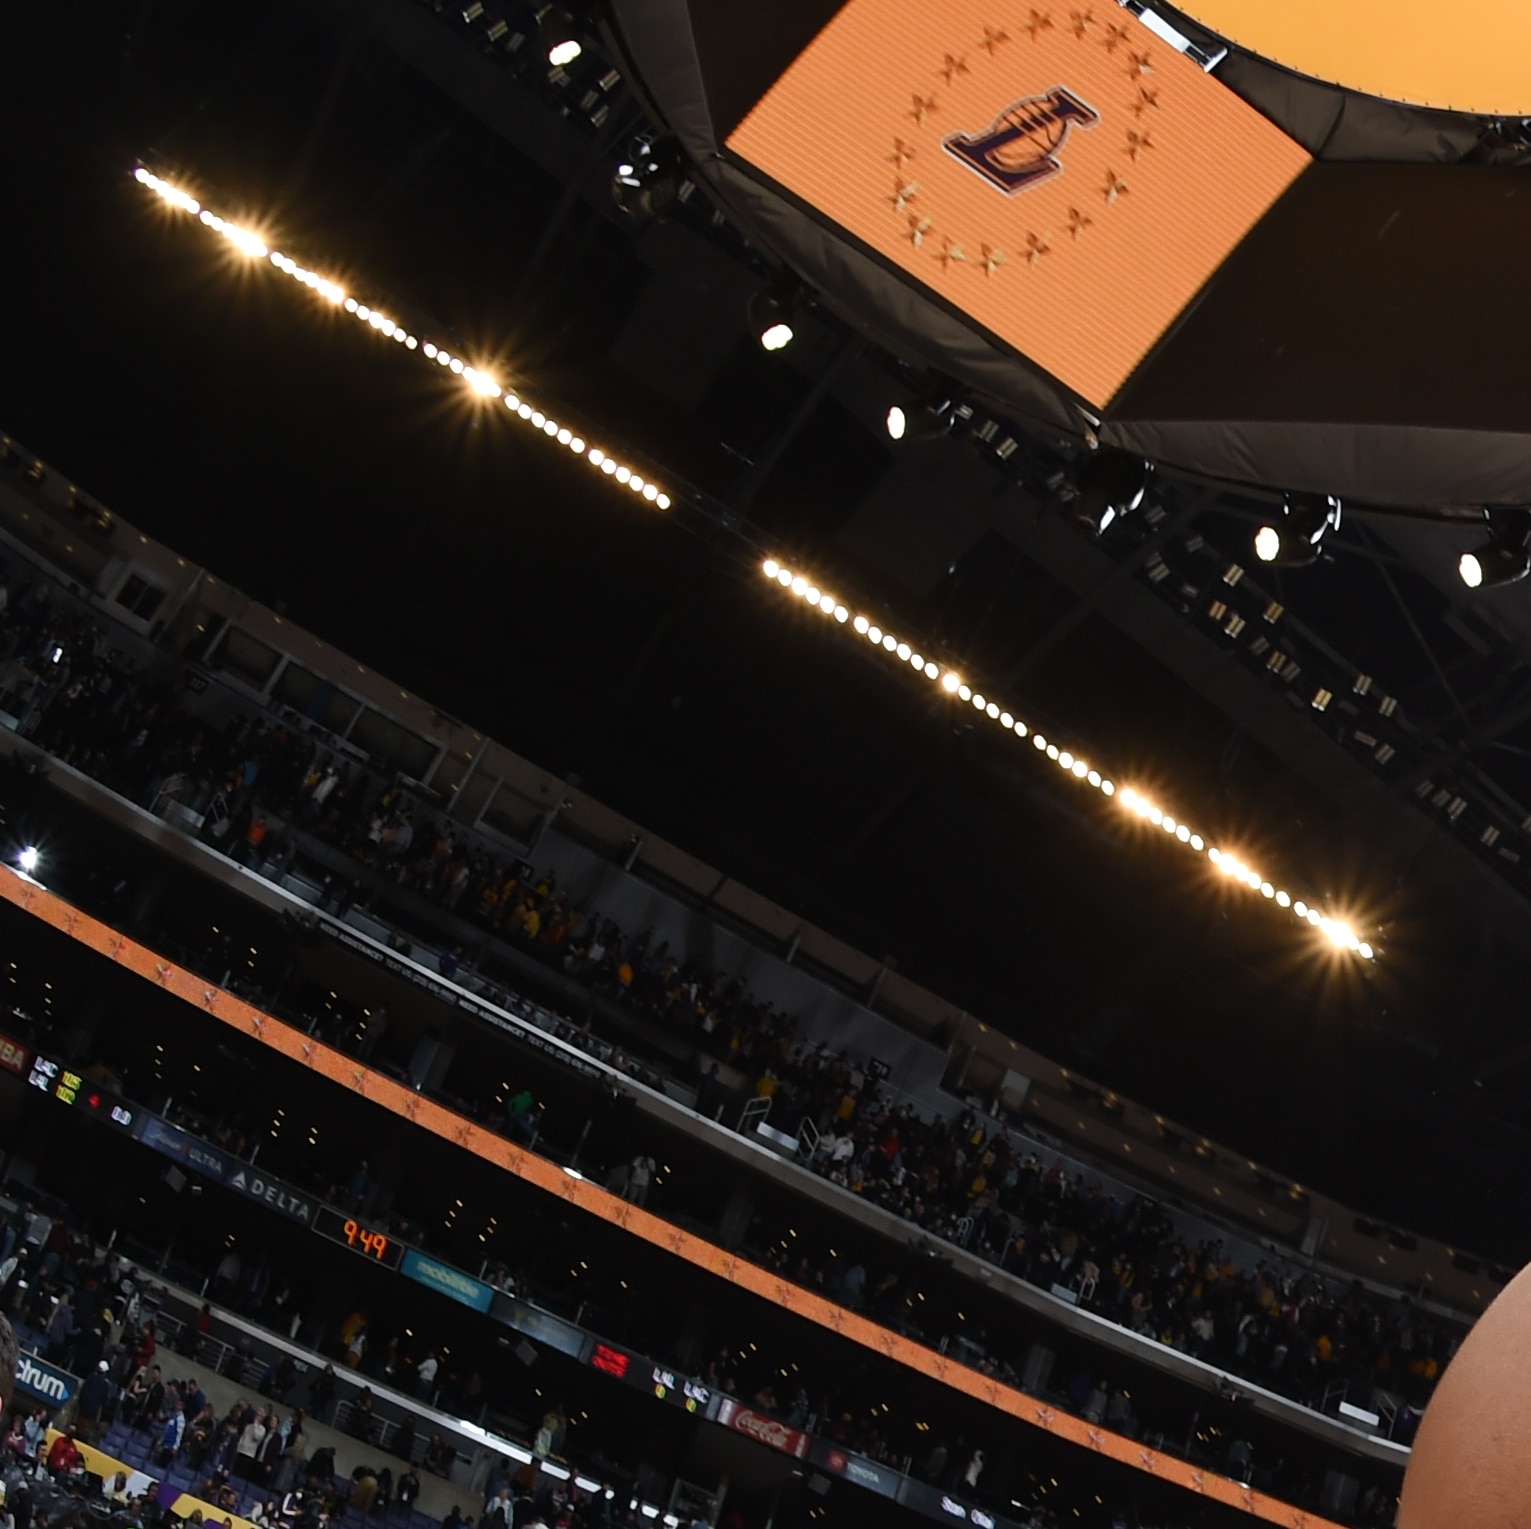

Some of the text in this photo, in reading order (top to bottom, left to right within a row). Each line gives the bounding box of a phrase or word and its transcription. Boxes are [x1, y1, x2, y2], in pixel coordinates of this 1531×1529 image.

[250, 1178, 311, 1221] DELTA
[15, 1361, 66, 1400] ctrum
[846, 1464, 880, 1484] TOYOTA
